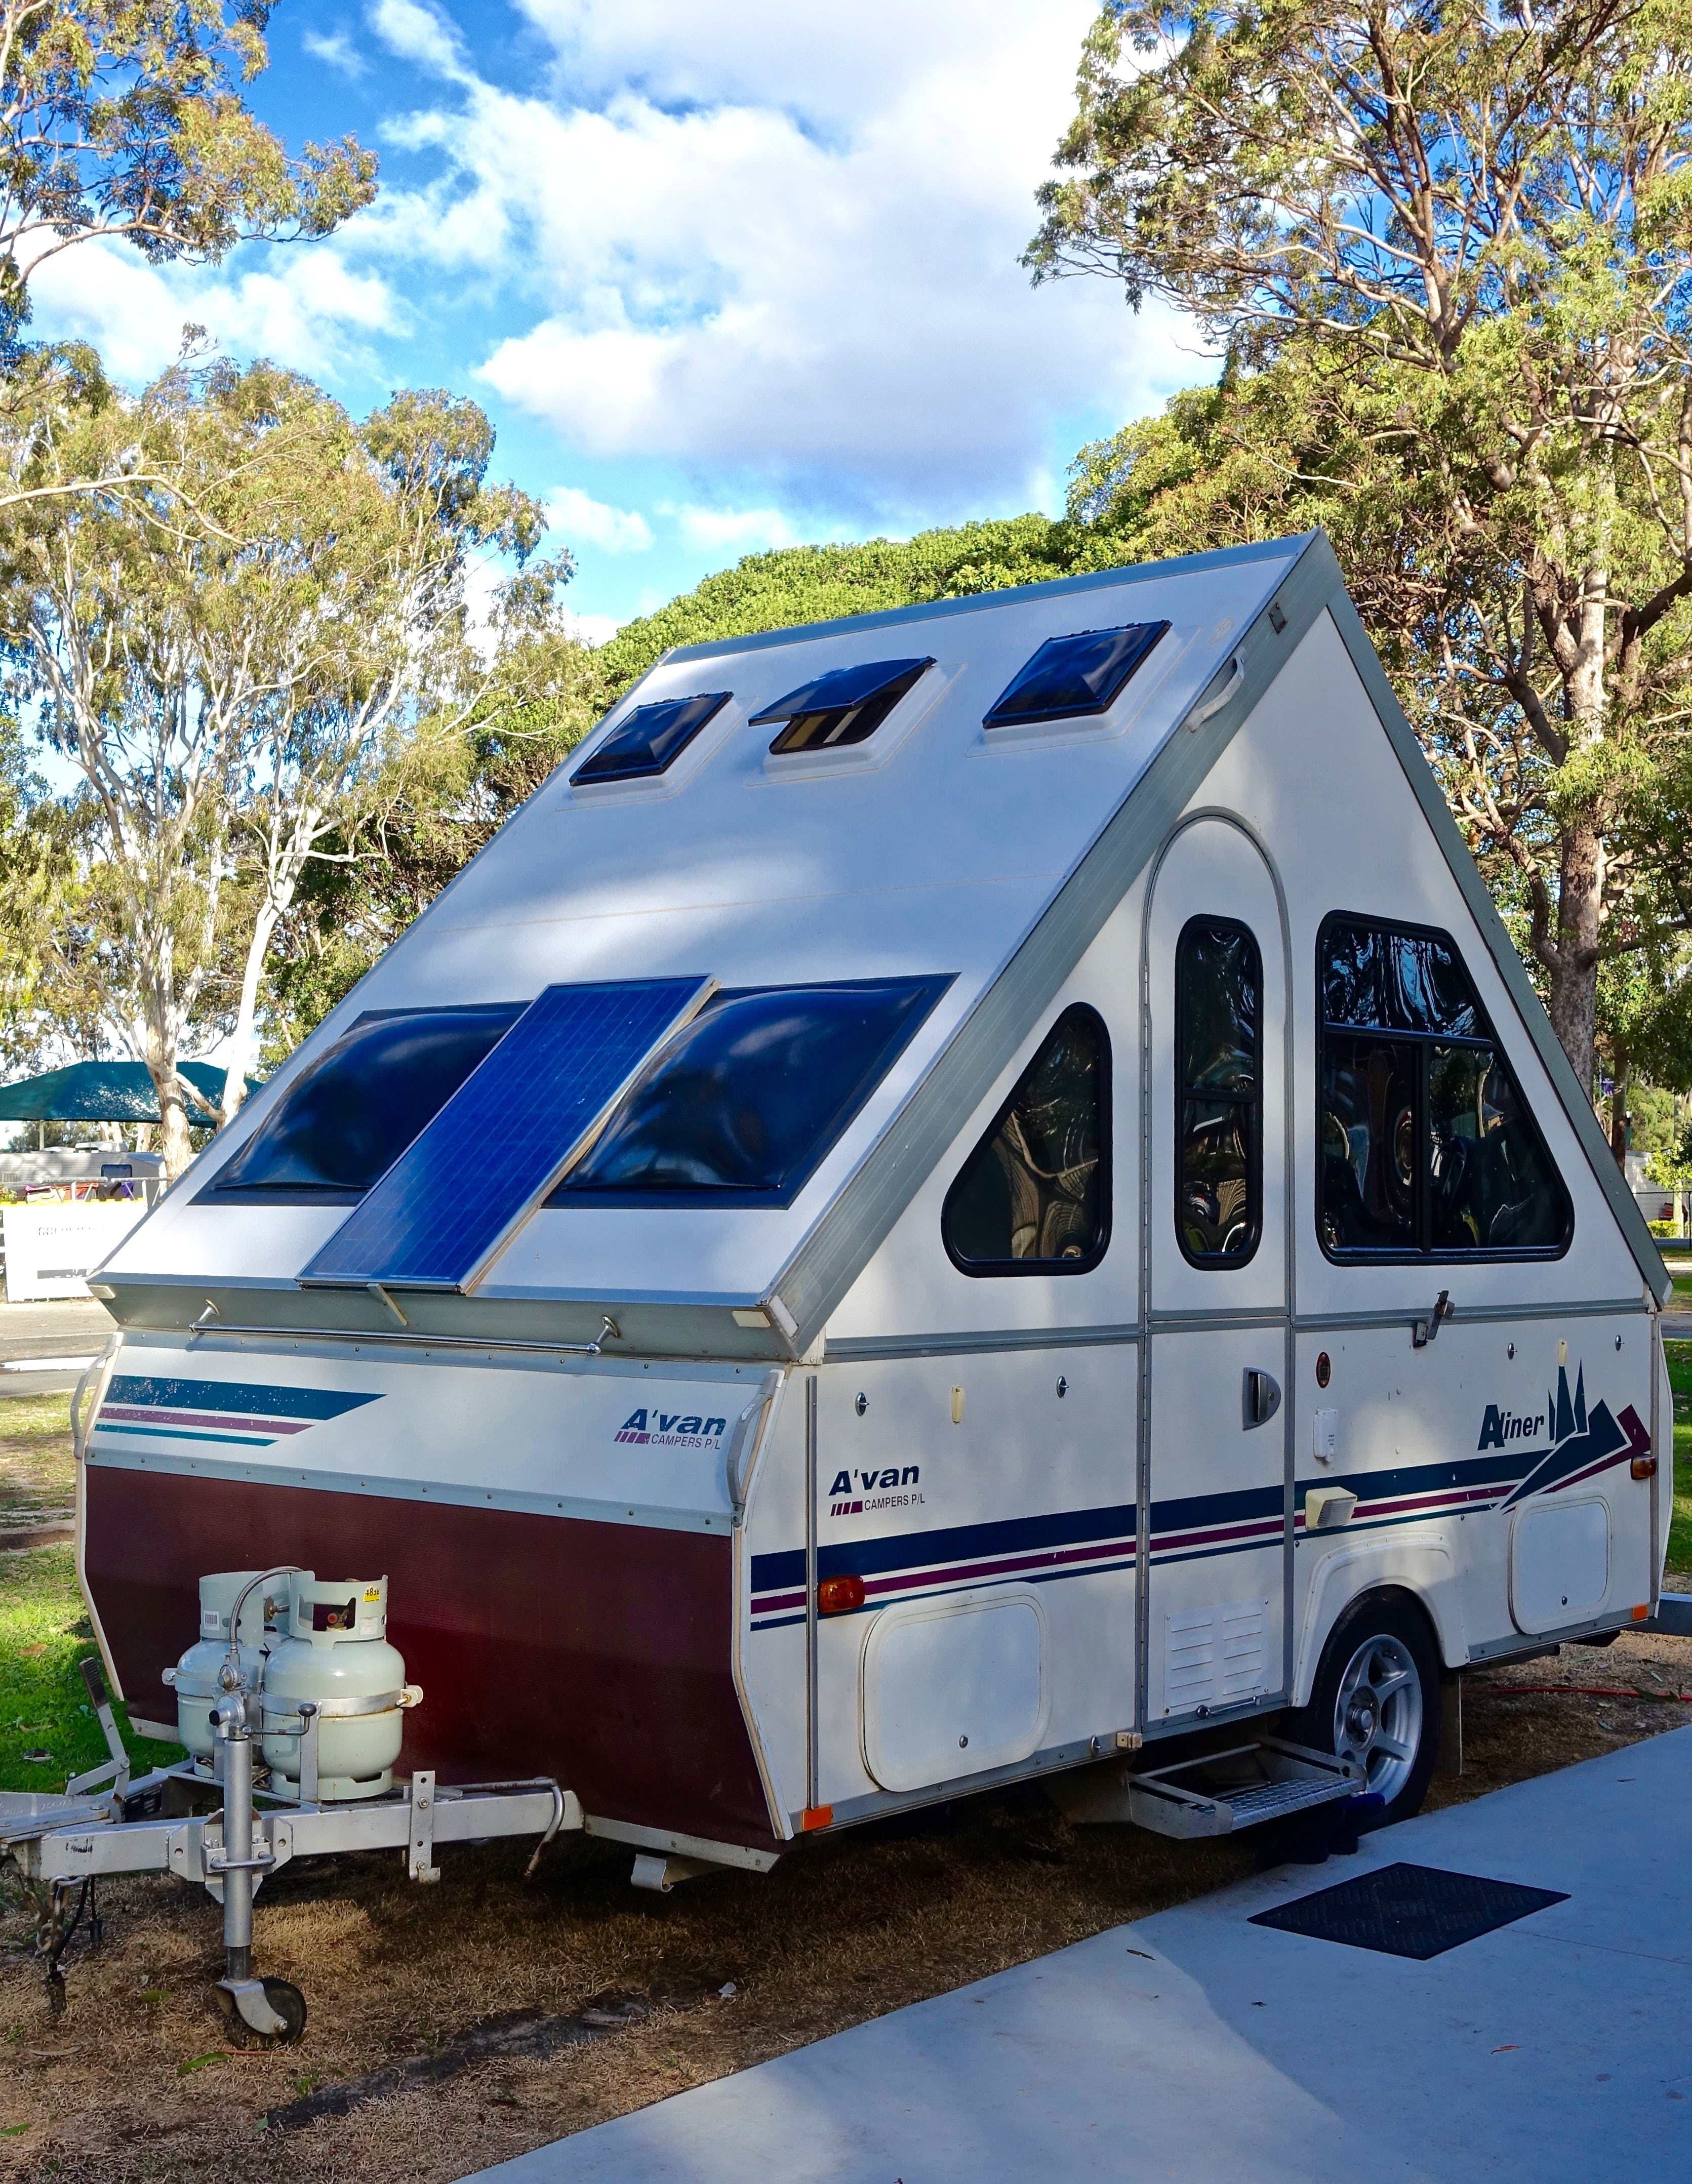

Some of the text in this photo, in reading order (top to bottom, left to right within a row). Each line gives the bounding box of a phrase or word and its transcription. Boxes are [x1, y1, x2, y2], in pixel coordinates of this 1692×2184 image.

[621, 1408, 727, 1436] A'van
[1477, 1404, 1544, 1450] Aliner
[651, 1433, 720, 1450] CAMPERS P/L
[828, 1465, 919, 1496] A'van
[864, 1492, 925, 1511] CAMPERS P/L
